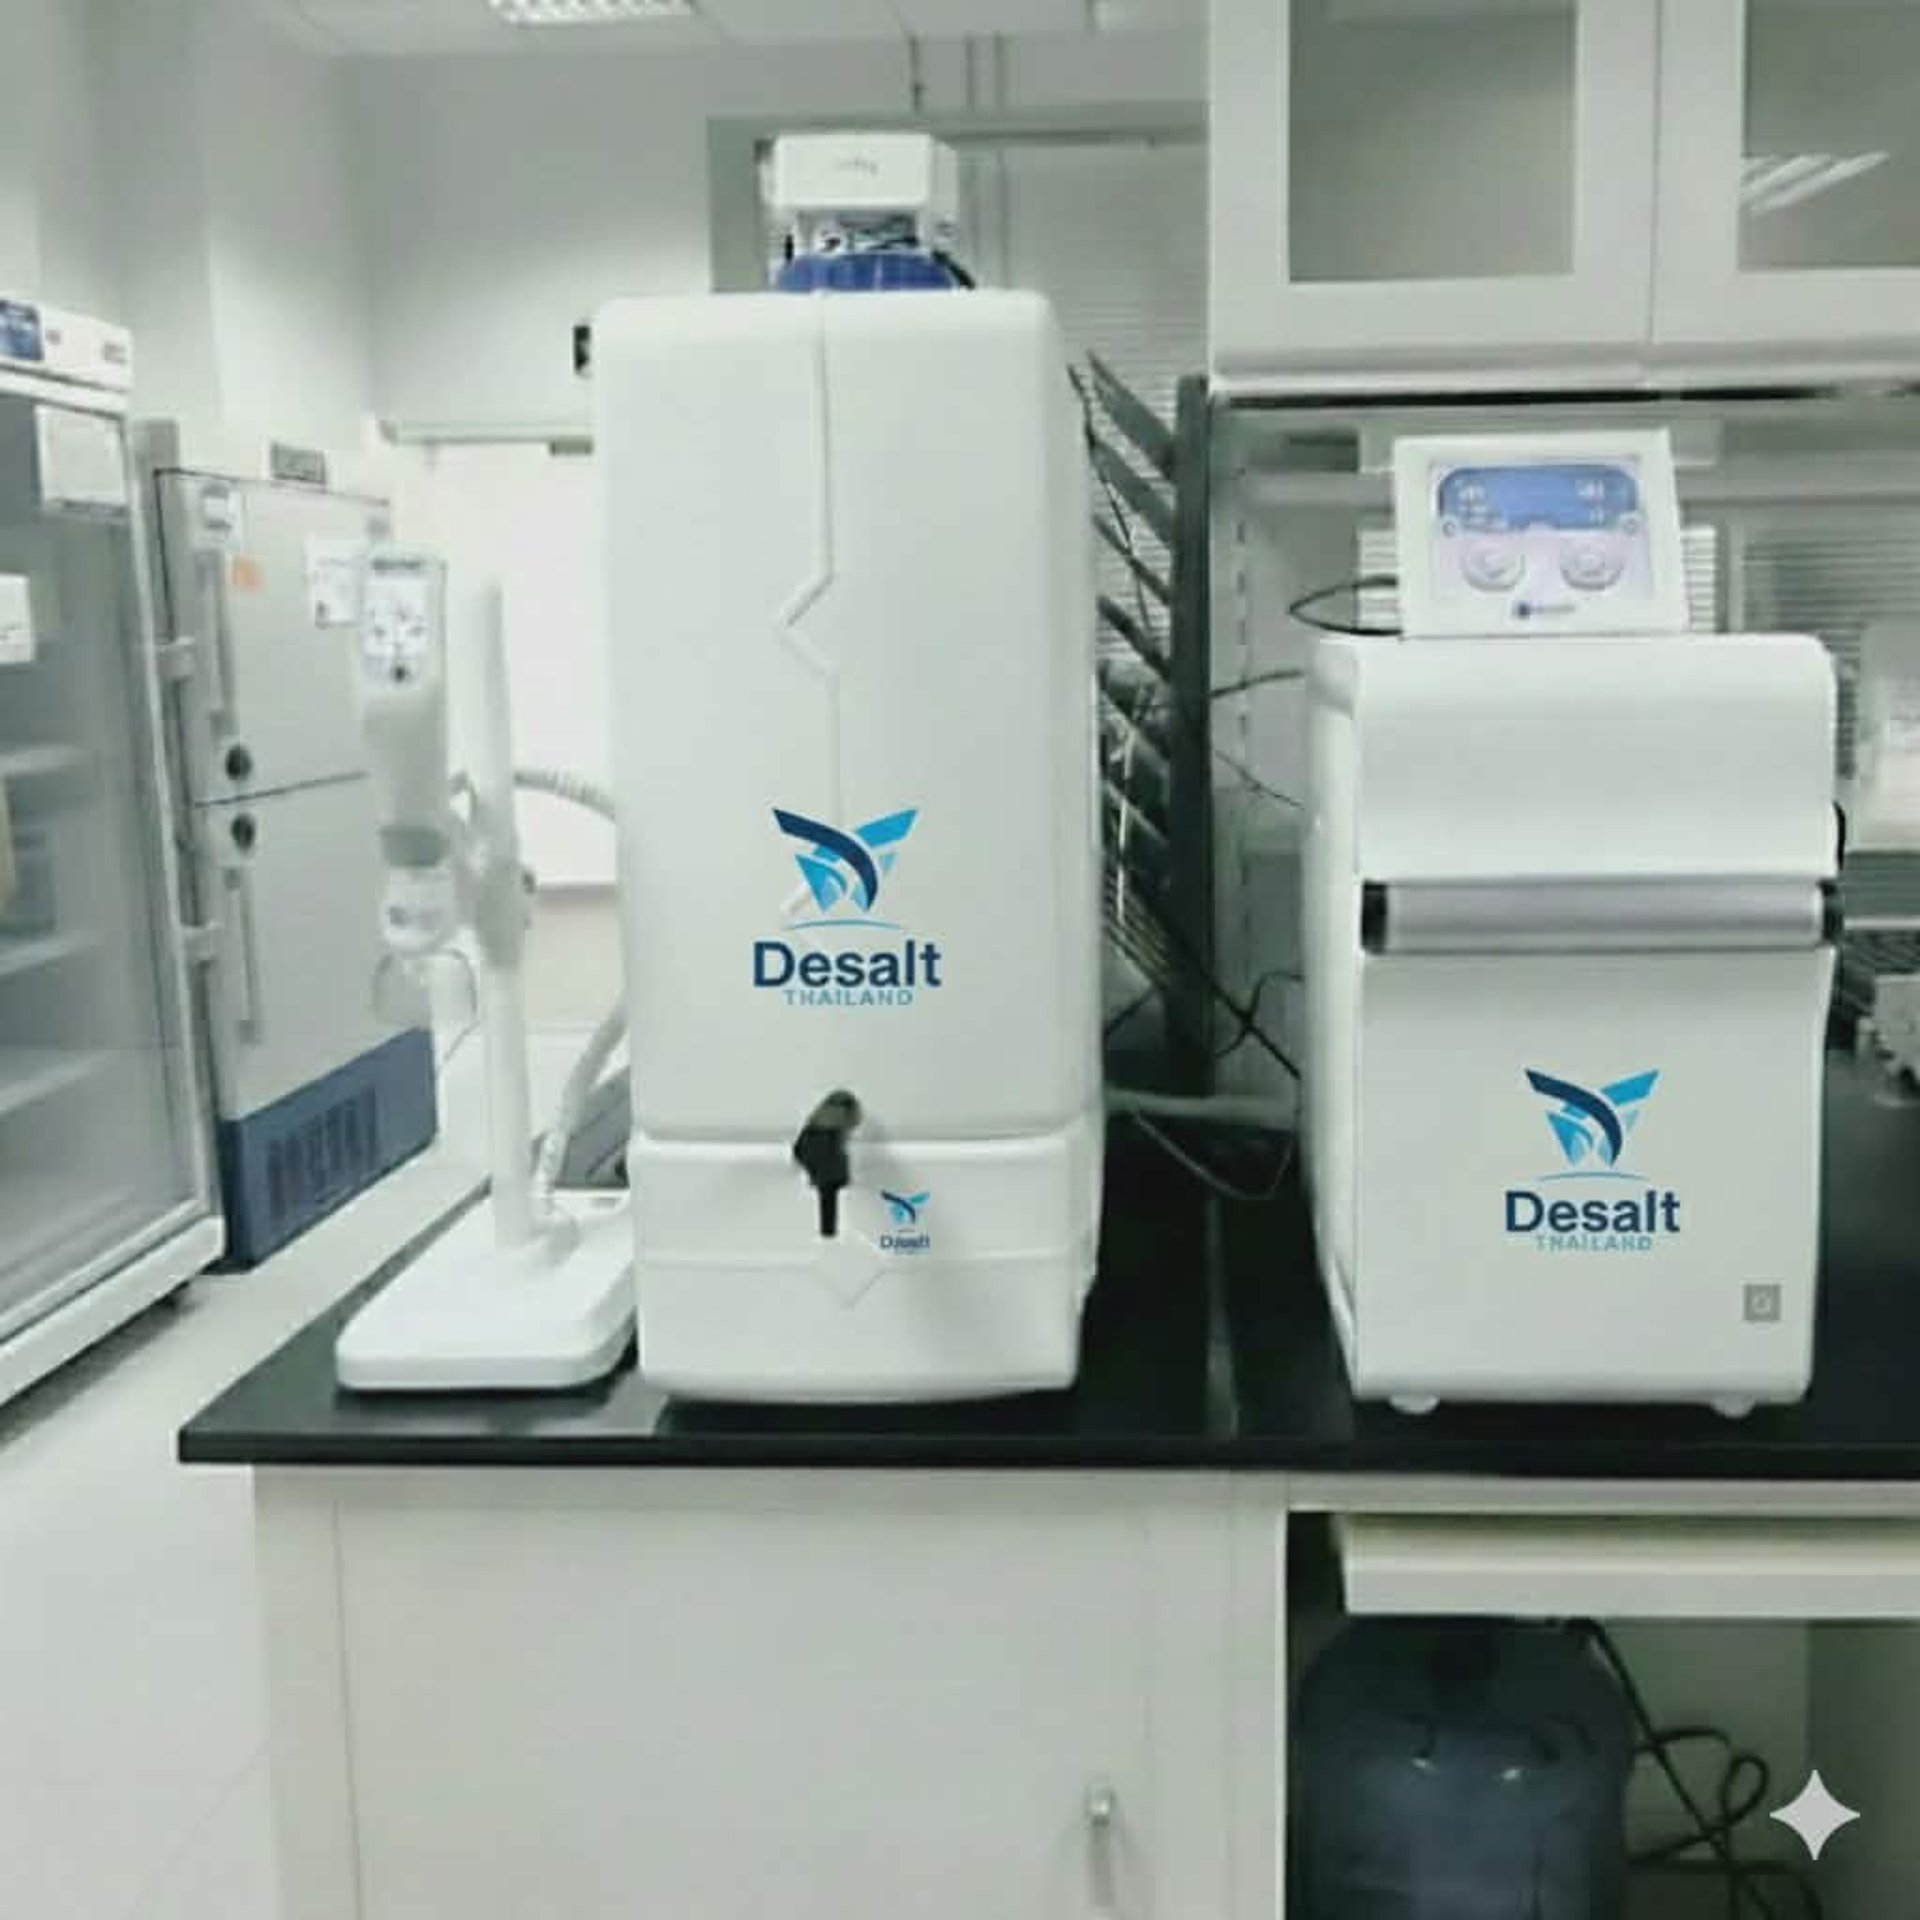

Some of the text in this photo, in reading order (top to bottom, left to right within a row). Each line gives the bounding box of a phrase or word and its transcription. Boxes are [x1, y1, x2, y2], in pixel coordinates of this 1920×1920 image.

[753, 939, 942, 988] Desalt
[783, 990, 914, 1006] THAILAND
[1505, 1189, 1681, 1234] Desalt
[1535, 1235, 1652, 1251] THAILAND
